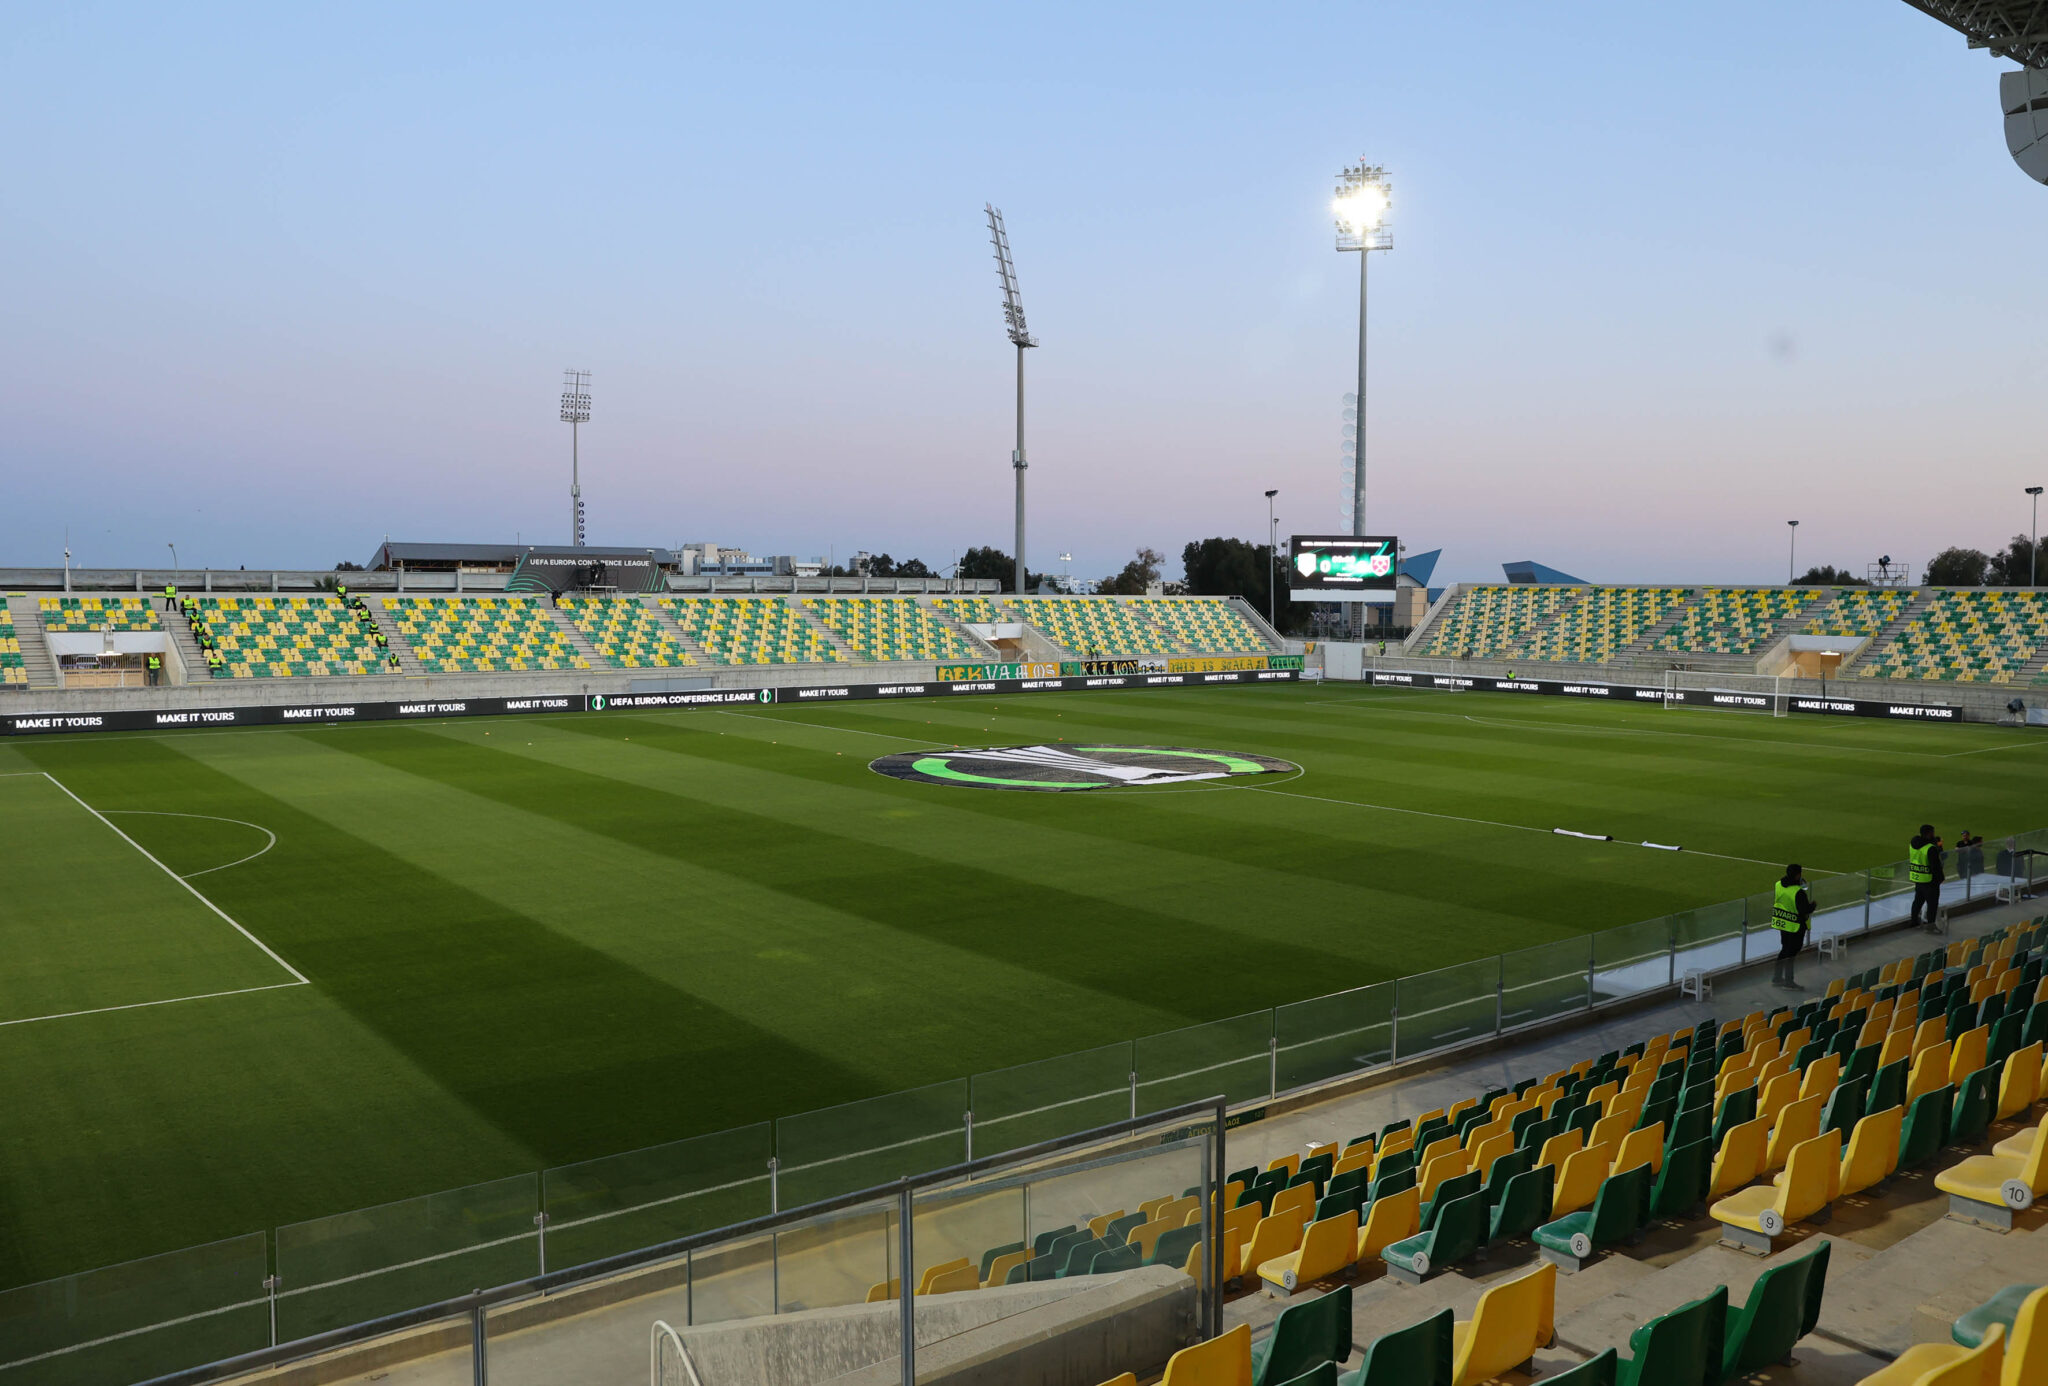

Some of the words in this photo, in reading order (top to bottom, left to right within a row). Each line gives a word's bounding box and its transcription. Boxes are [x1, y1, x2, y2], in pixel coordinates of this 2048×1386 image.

[529, 558, 549, 566] UEFA
[1148, 676, 1162, 684] MAKE
[1455, 679, 1473, 687] YOURS
[879, 687, 897, 695] MAKE
[1564, 686, 1581, 694] MAKE
[1589, 687, 1609, 695] YOURS
[1636, 690, 1655, 698] MAKE
[1655, 691, 1663, 699] IT
[1664, 692, 1684, 700] YOURS
[507, 700, 531, 709] MAKE
[531, 700, 540, 708] IT
[541, 699, 568, 707] YOURS
[610, 697, 634, 706] UEFA
[635, 695, 667, 705] EUROPA
[669, 693, 724, 704] CONFERENCE
[725, 692, 755, 702] LEAGUE
[1714, 695, 1734, 704] MAKE
[1743, 697, 1766, 706] YOURS
[400, 704, 426, 713] MAKE
[427, 704, 436, 712] IT
[438, 702, 465, 712] YOURS
[1798, 700, 1820, 709] MAKE
[1830, 702, 1855, 711] YOURS
[284, 709, 312, 718] MAKE
[313, 708, 323, 717] IT
[324, 706, 355, 716] YOURS
[1889, 706, 1913, 716] MAKE
[1915, 708, 1924, 716] IT
[1925, 708, 1952, 717] YOURS
[16, 719, 51, 729] MAKE
[52, 717, 64, 728] IT
[66, 716, 103, 727] YOURS
[157, 714, 187, 724] MAKE
[188, 713, 199, 723] IT
[201, 711, 235, 721] YOURS
[2008, 1186, 2025, 1203] 10
[1765, 1216, 1775, 1230] 9
[1577, 1240, 1583, 1252] 8
[1416, 1257, 1423, 1268] 7
[1286, 1275, 1291, 1285] 6
